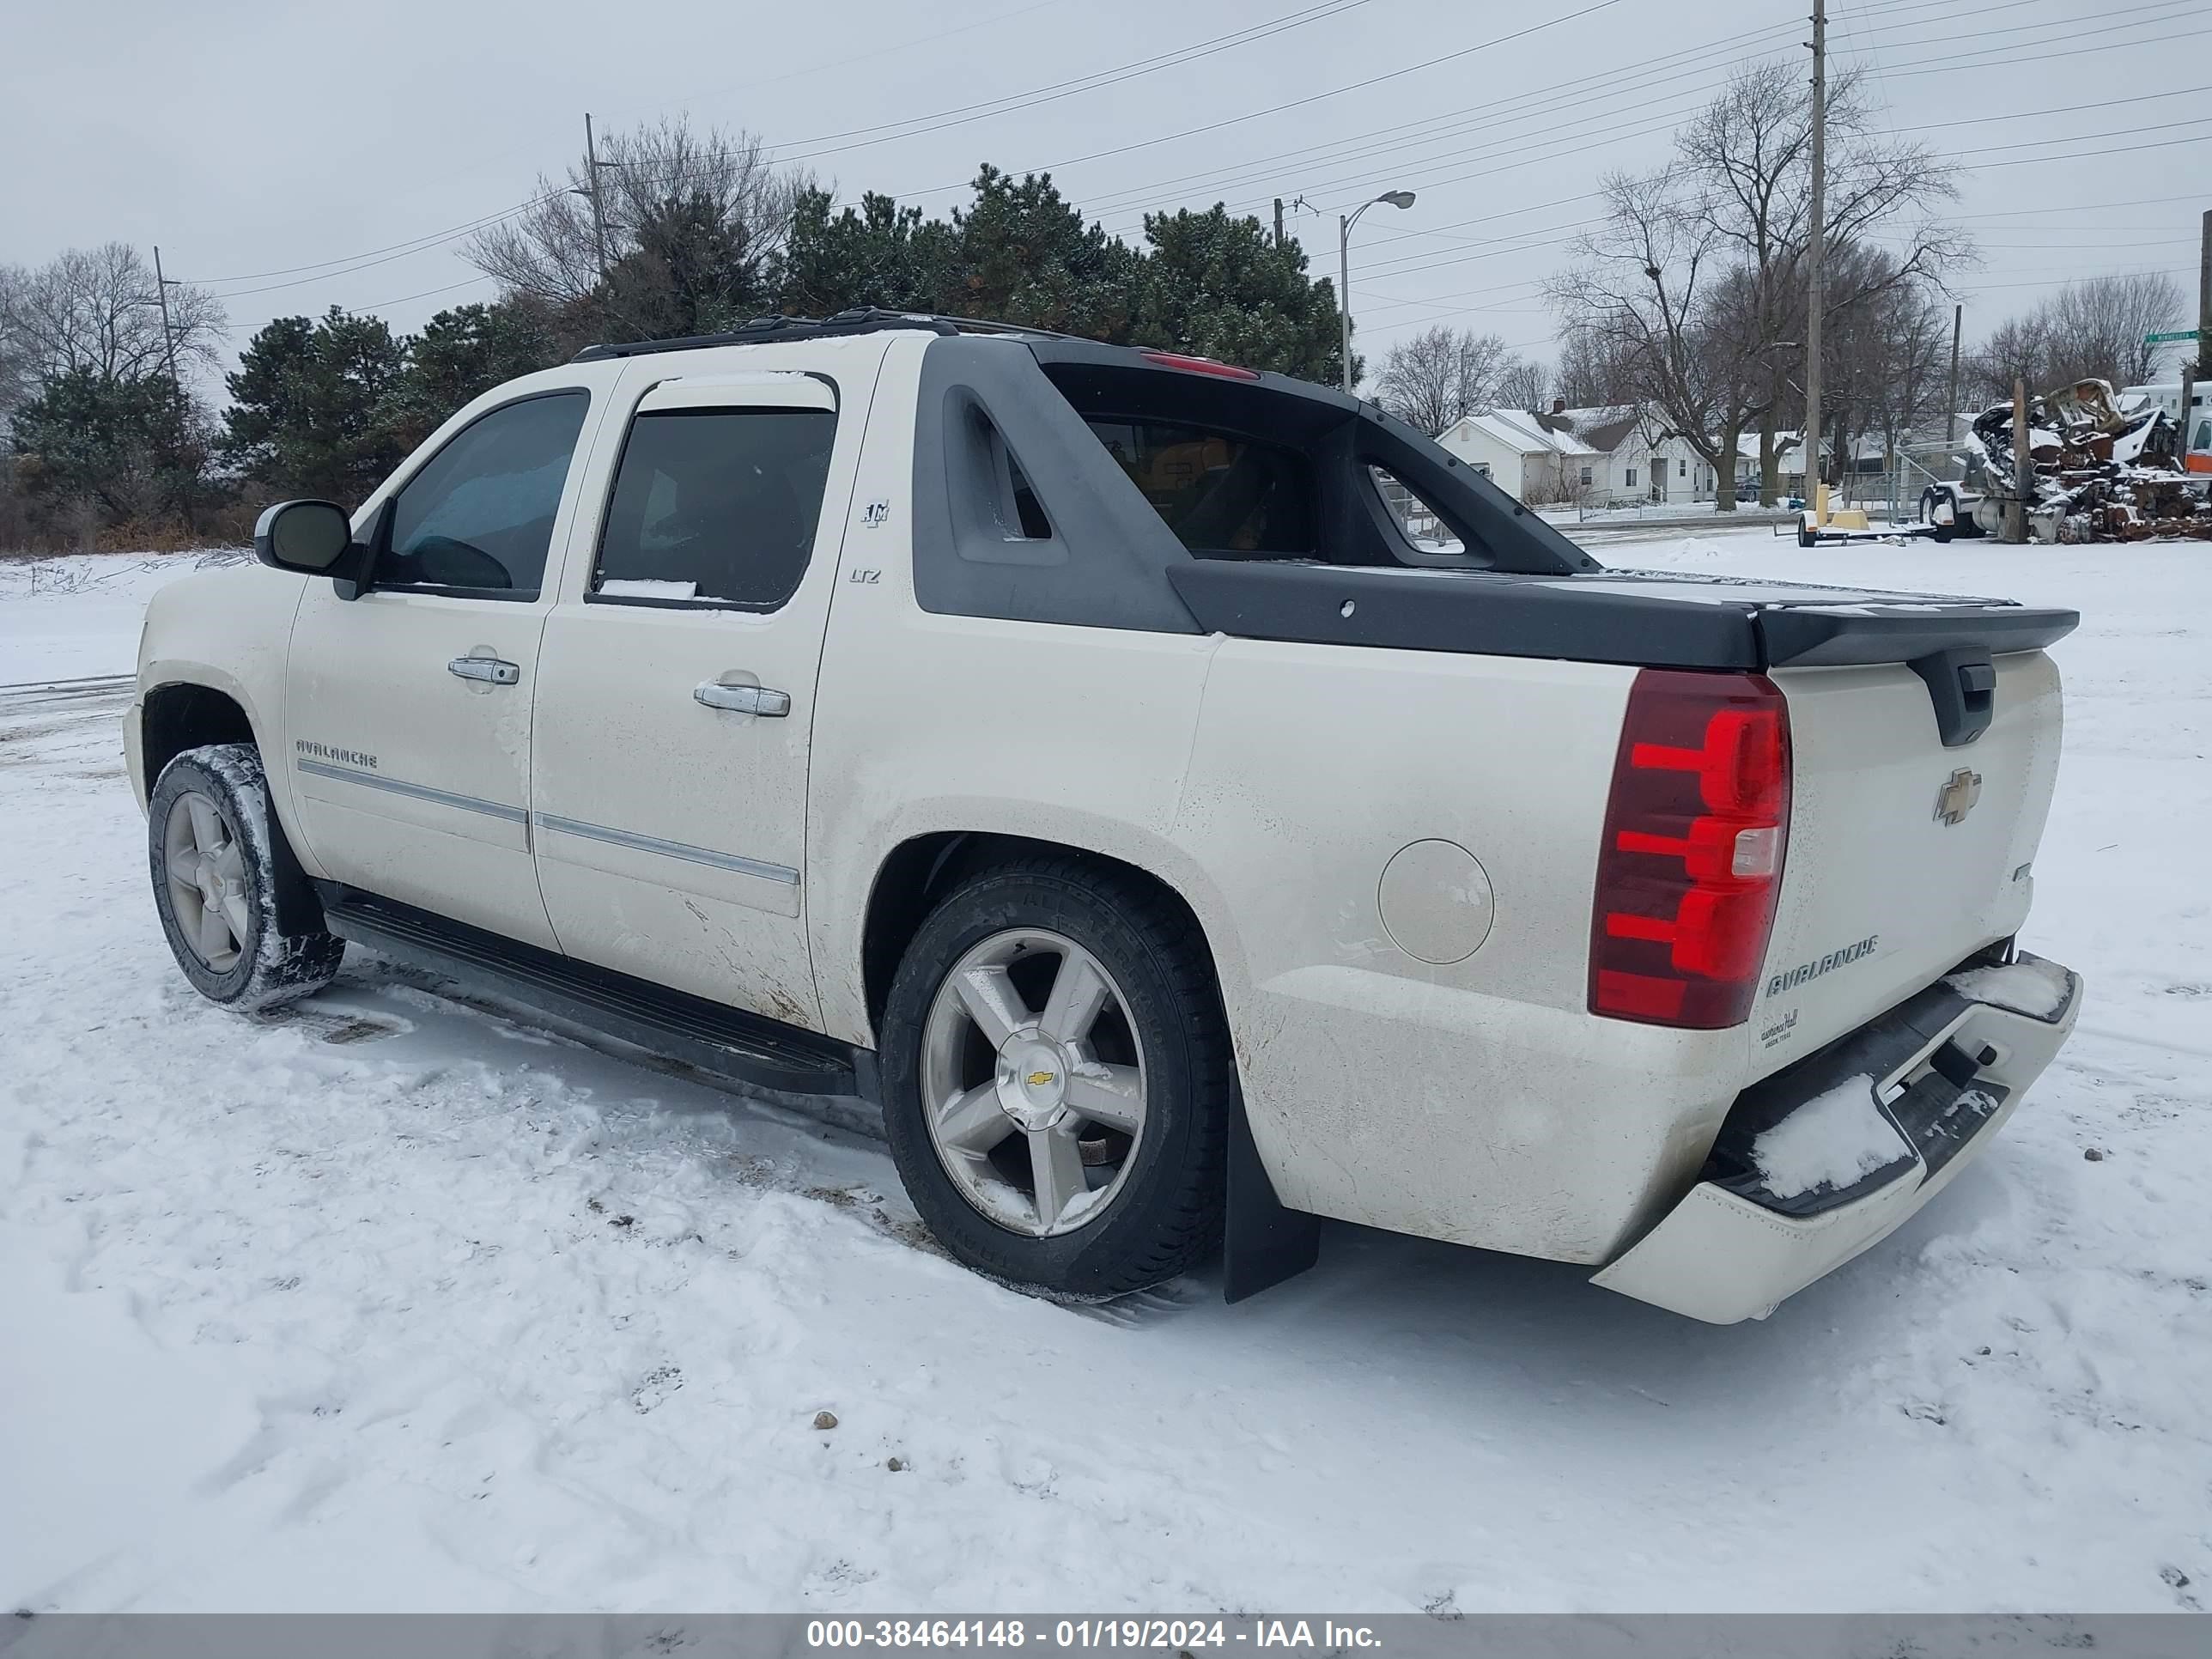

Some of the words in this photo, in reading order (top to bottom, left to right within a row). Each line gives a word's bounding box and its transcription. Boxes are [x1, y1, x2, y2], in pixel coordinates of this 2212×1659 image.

[849, 568, 882, 584] LTZ
[296, 739, 378, 769] AVALANCHE
[1766, 935, 1879, 998] AVALANCHE
